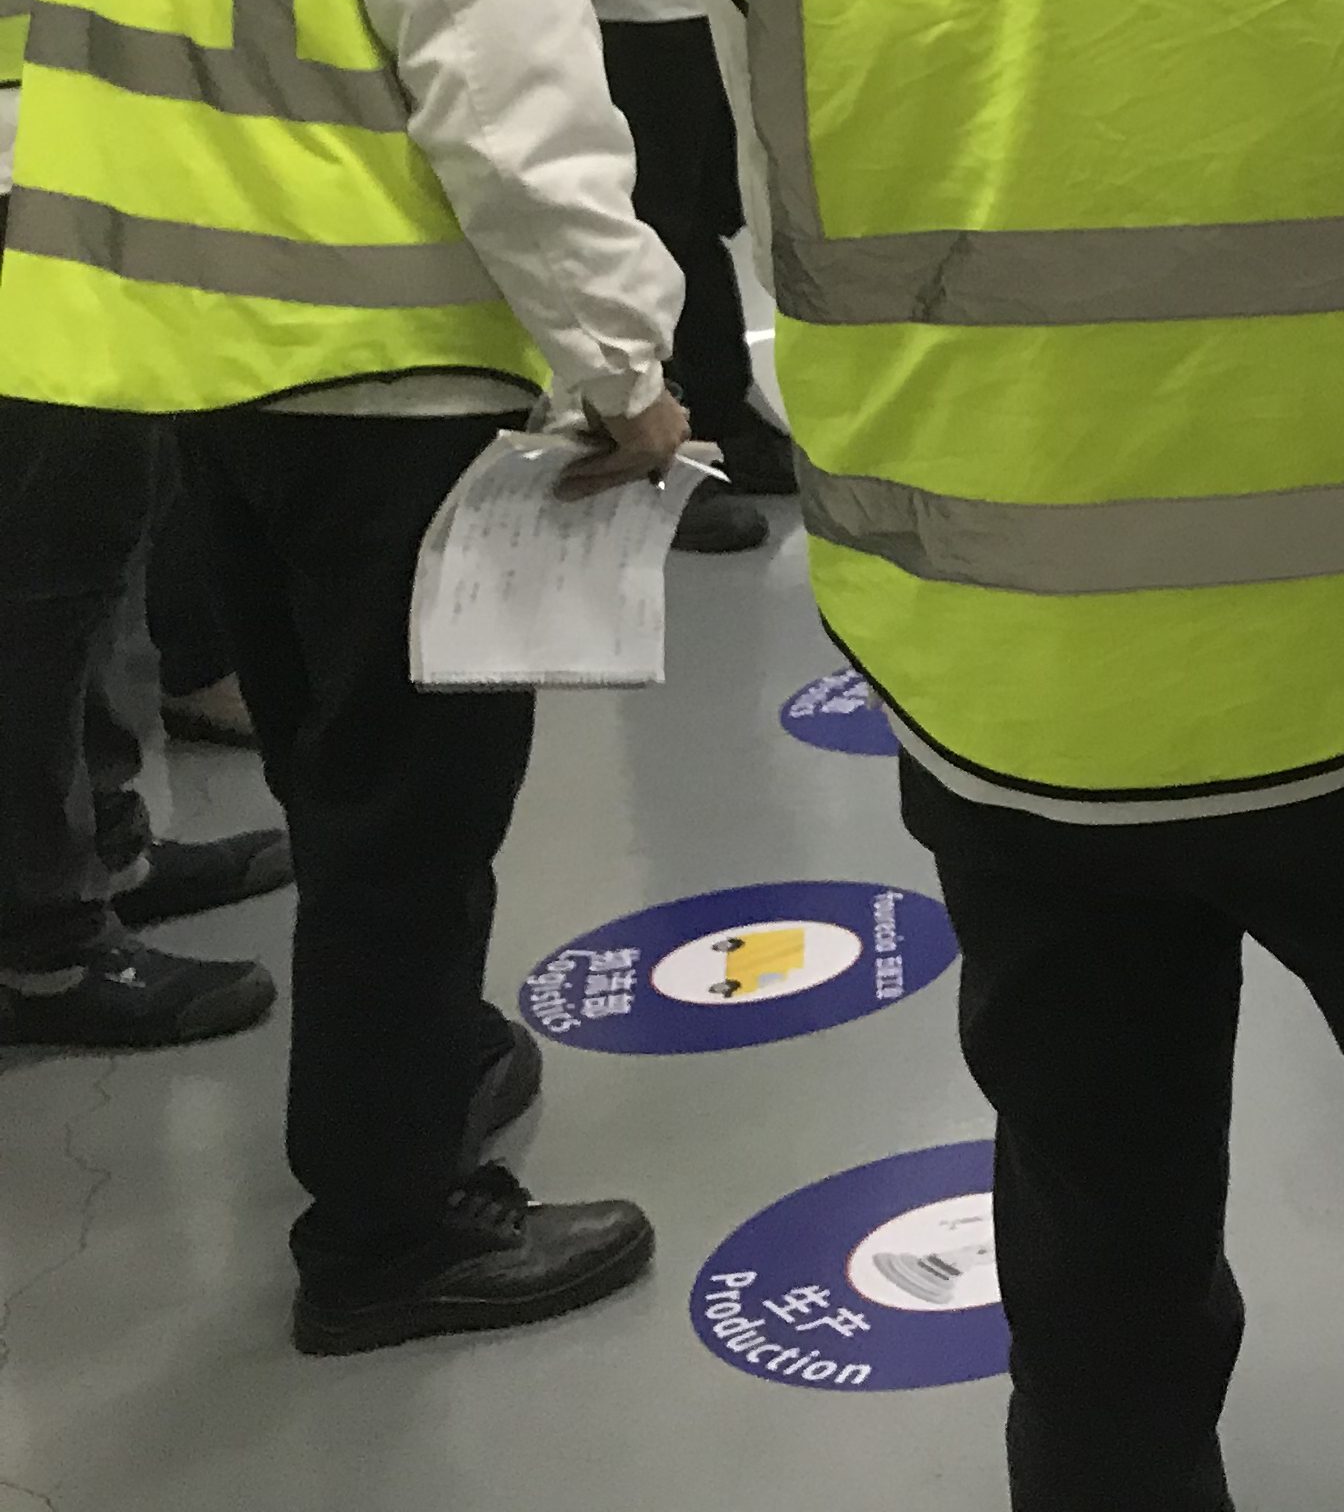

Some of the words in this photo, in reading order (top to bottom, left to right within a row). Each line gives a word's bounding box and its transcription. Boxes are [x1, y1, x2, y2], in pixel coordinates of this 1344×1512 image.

[526, 948, 597, 1034] Logistics
[704, 1270, 872, 1385] Production
[762, 1285, 872, 1338] 生产
